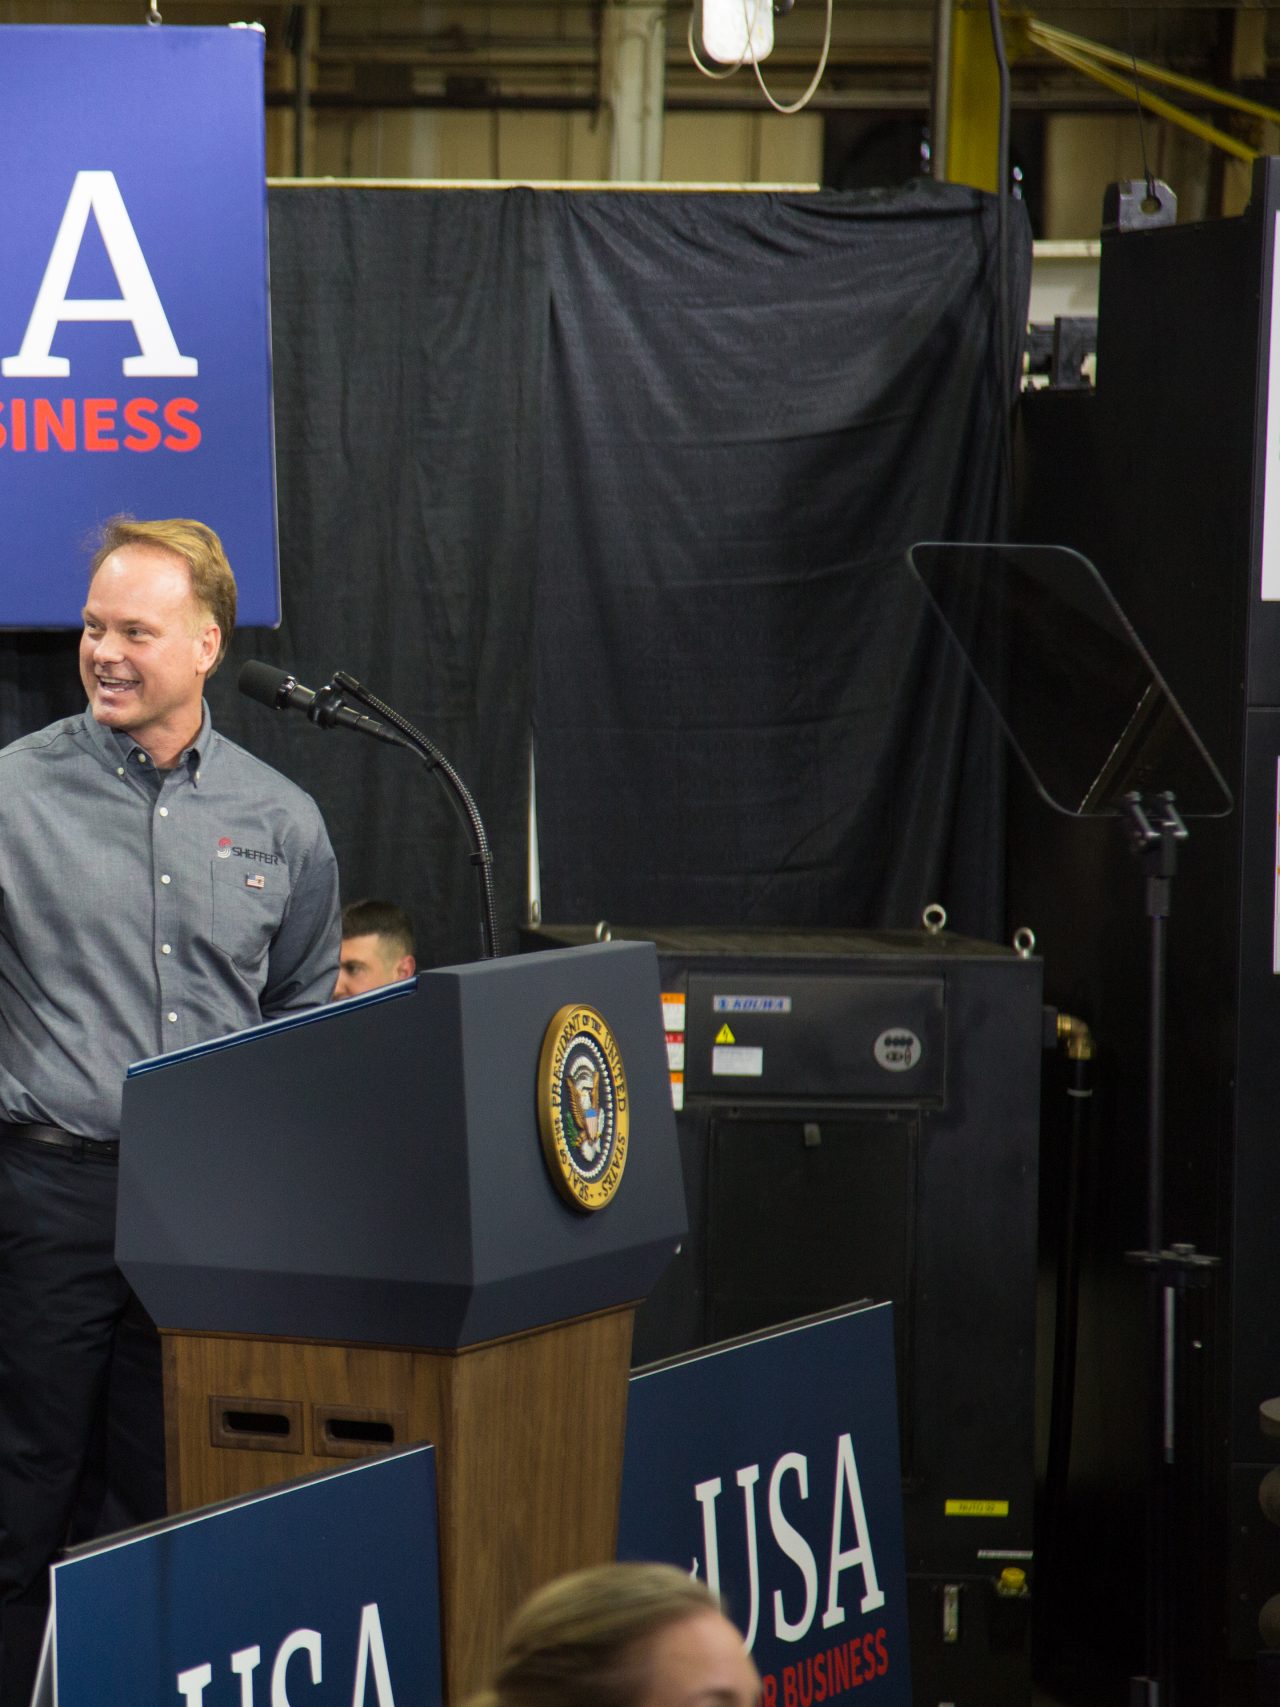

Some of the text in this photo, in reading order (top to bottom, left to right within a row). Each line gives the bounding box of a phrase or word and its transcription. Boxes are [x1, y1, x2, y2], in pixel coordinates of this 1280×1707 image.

[231, 846, 279, 865] SHEFFER
[604, 1031, 626, 1113] UNITED
[601, 1132, 626, 1198] STATES
[694, 1433, 885, 1655] USA
[783, 1627, 889, 1707] BUSINESS
